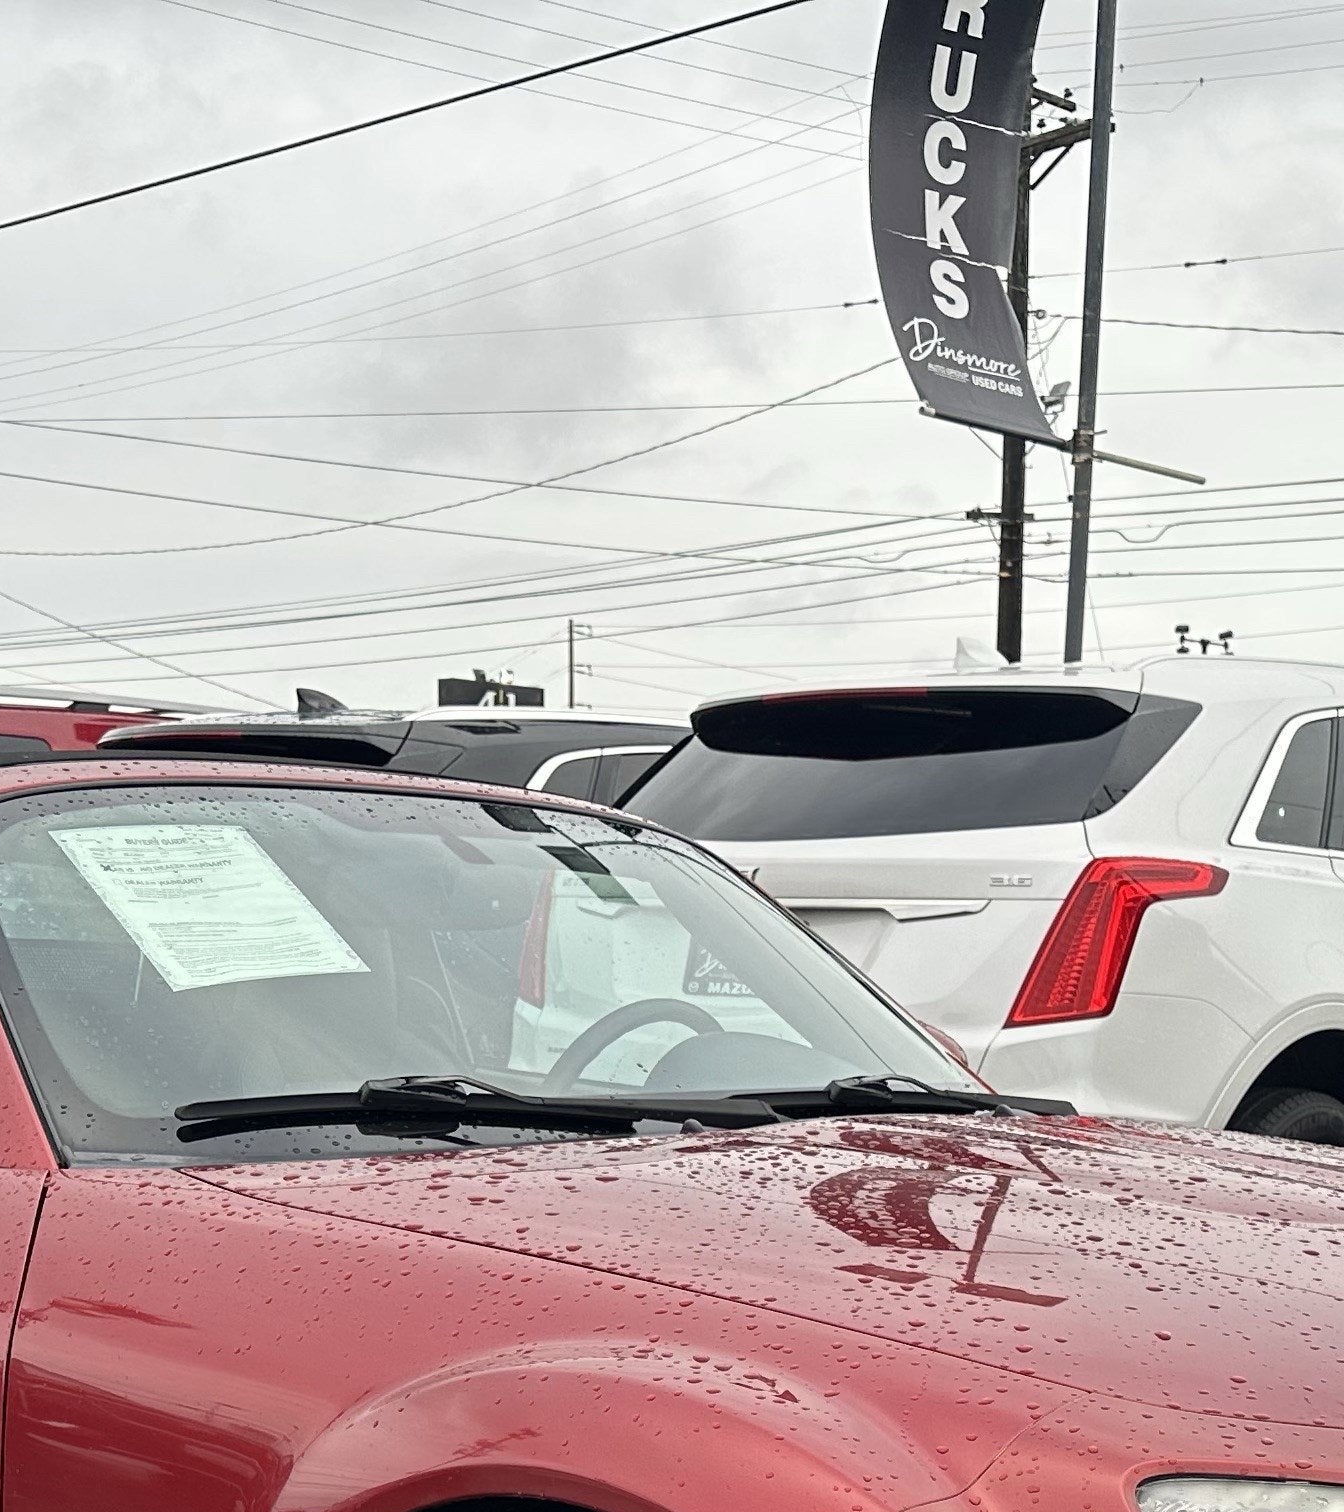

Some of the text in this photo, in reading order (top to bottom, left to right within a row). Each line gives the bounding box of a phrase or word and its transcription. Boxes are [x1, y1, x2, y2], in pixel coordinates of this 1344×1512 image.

[902, 317, 1022, 378] Dinsmore
[972, 374, 1024, 397] USED CARS
